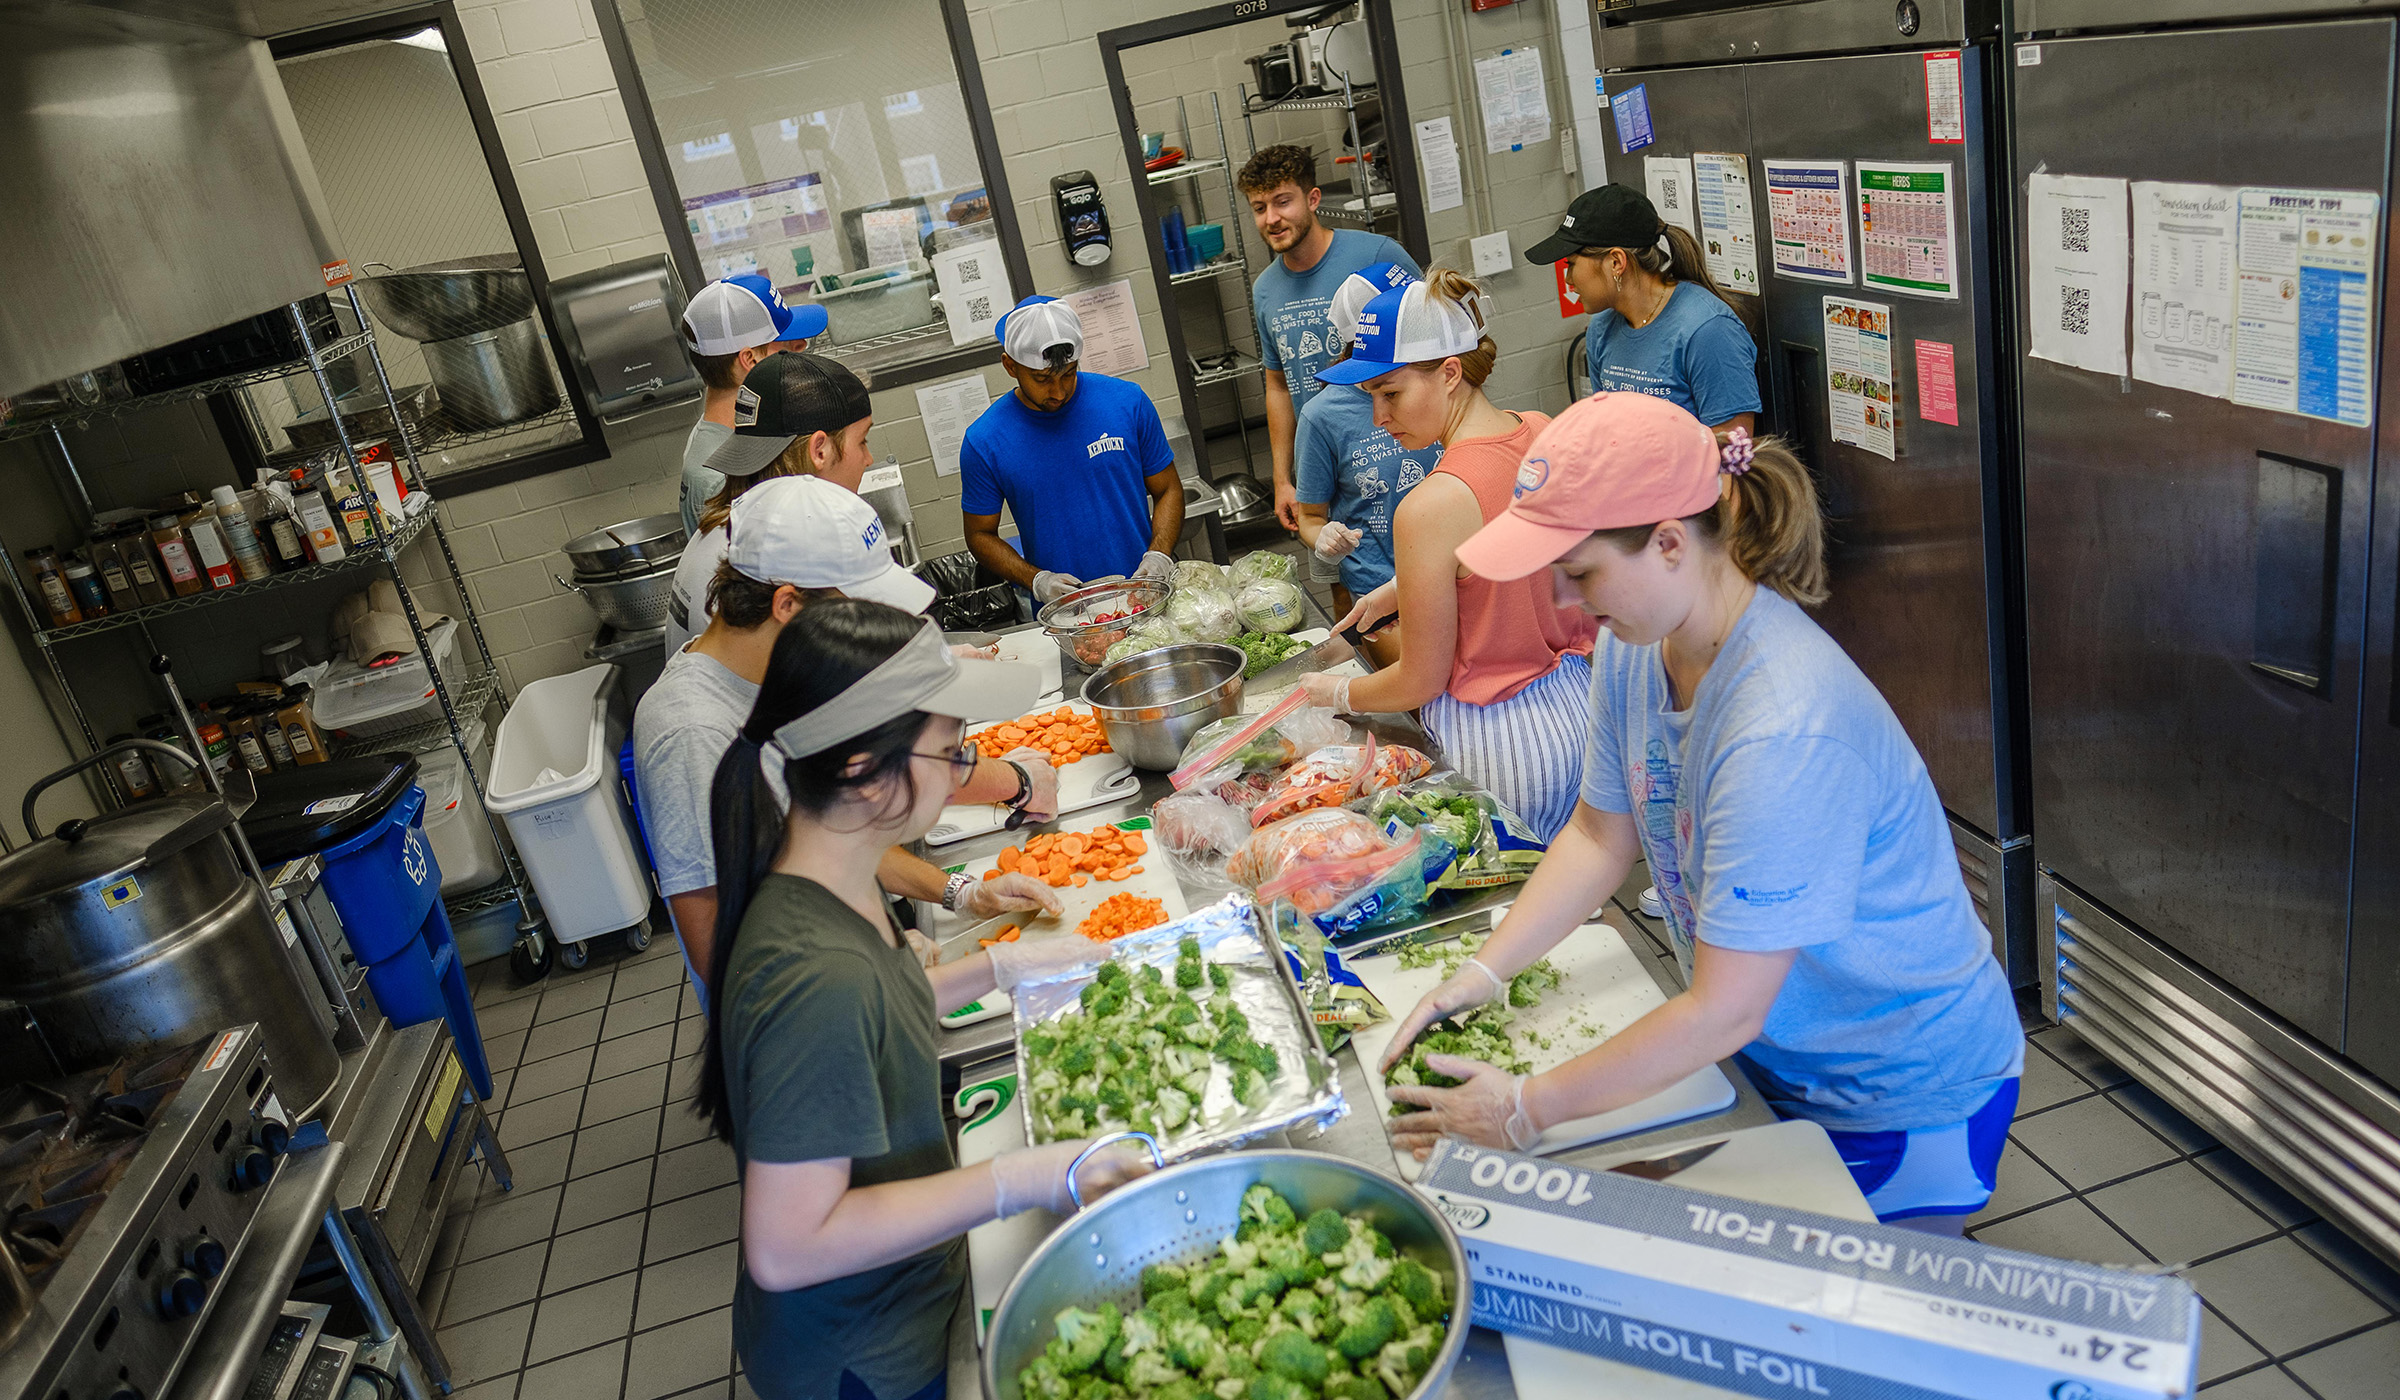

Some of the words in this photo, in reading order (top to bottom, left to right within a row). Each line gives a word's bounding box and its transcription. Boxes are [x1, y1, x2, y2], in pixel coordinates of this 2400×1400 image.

[1235, 0, 1268, 16] 207-B
[1892, 175, 1910, 188] HERBS
[2269, 196, 2315, 209] FREEZING
[2319, 199, 2342, 211] TIPS
[628, 298, 662, 311] enMotion
[1272, 313, 1296, 325] GLOBAL
[1298, 309, 1316, 319] FOOD
[1283, 319, 1305, 330] WASTE
[1307, 317, 1324, 326] PER
[1087, 437, 1124, 459] KENTUCKY
[1352, 442, 1390, 459] GLOBAL
[1352, 457, 1369, 467] AND
[1371, 447, 1403, 462] WASTE
[1373, 506, 1384, 514] 1/3
[1484, 875, 1511, 885] DEAL!
[1316, 1013, 1347, 1022] DEAL!
[1452, 1145, 1480, 1163] FT
[1470, 1154, 1594, 1207] 1000
[1685, 1203, 1777, 1246] FOIL
[1785, 1223, 1898, 1272] ROLL
[1484, 1265, 1583, 1298] STANDARD
[1904, 1248, 2158, 1322] ALUMINUM
[1927, 1300, 2058, 1338] STANDARD
[1472, 1287, 1612, 1343] UMINUM
[1620, 1321, 1725, 1371] ROLL
[1733, 1348, 1831, 1396] FOIL
